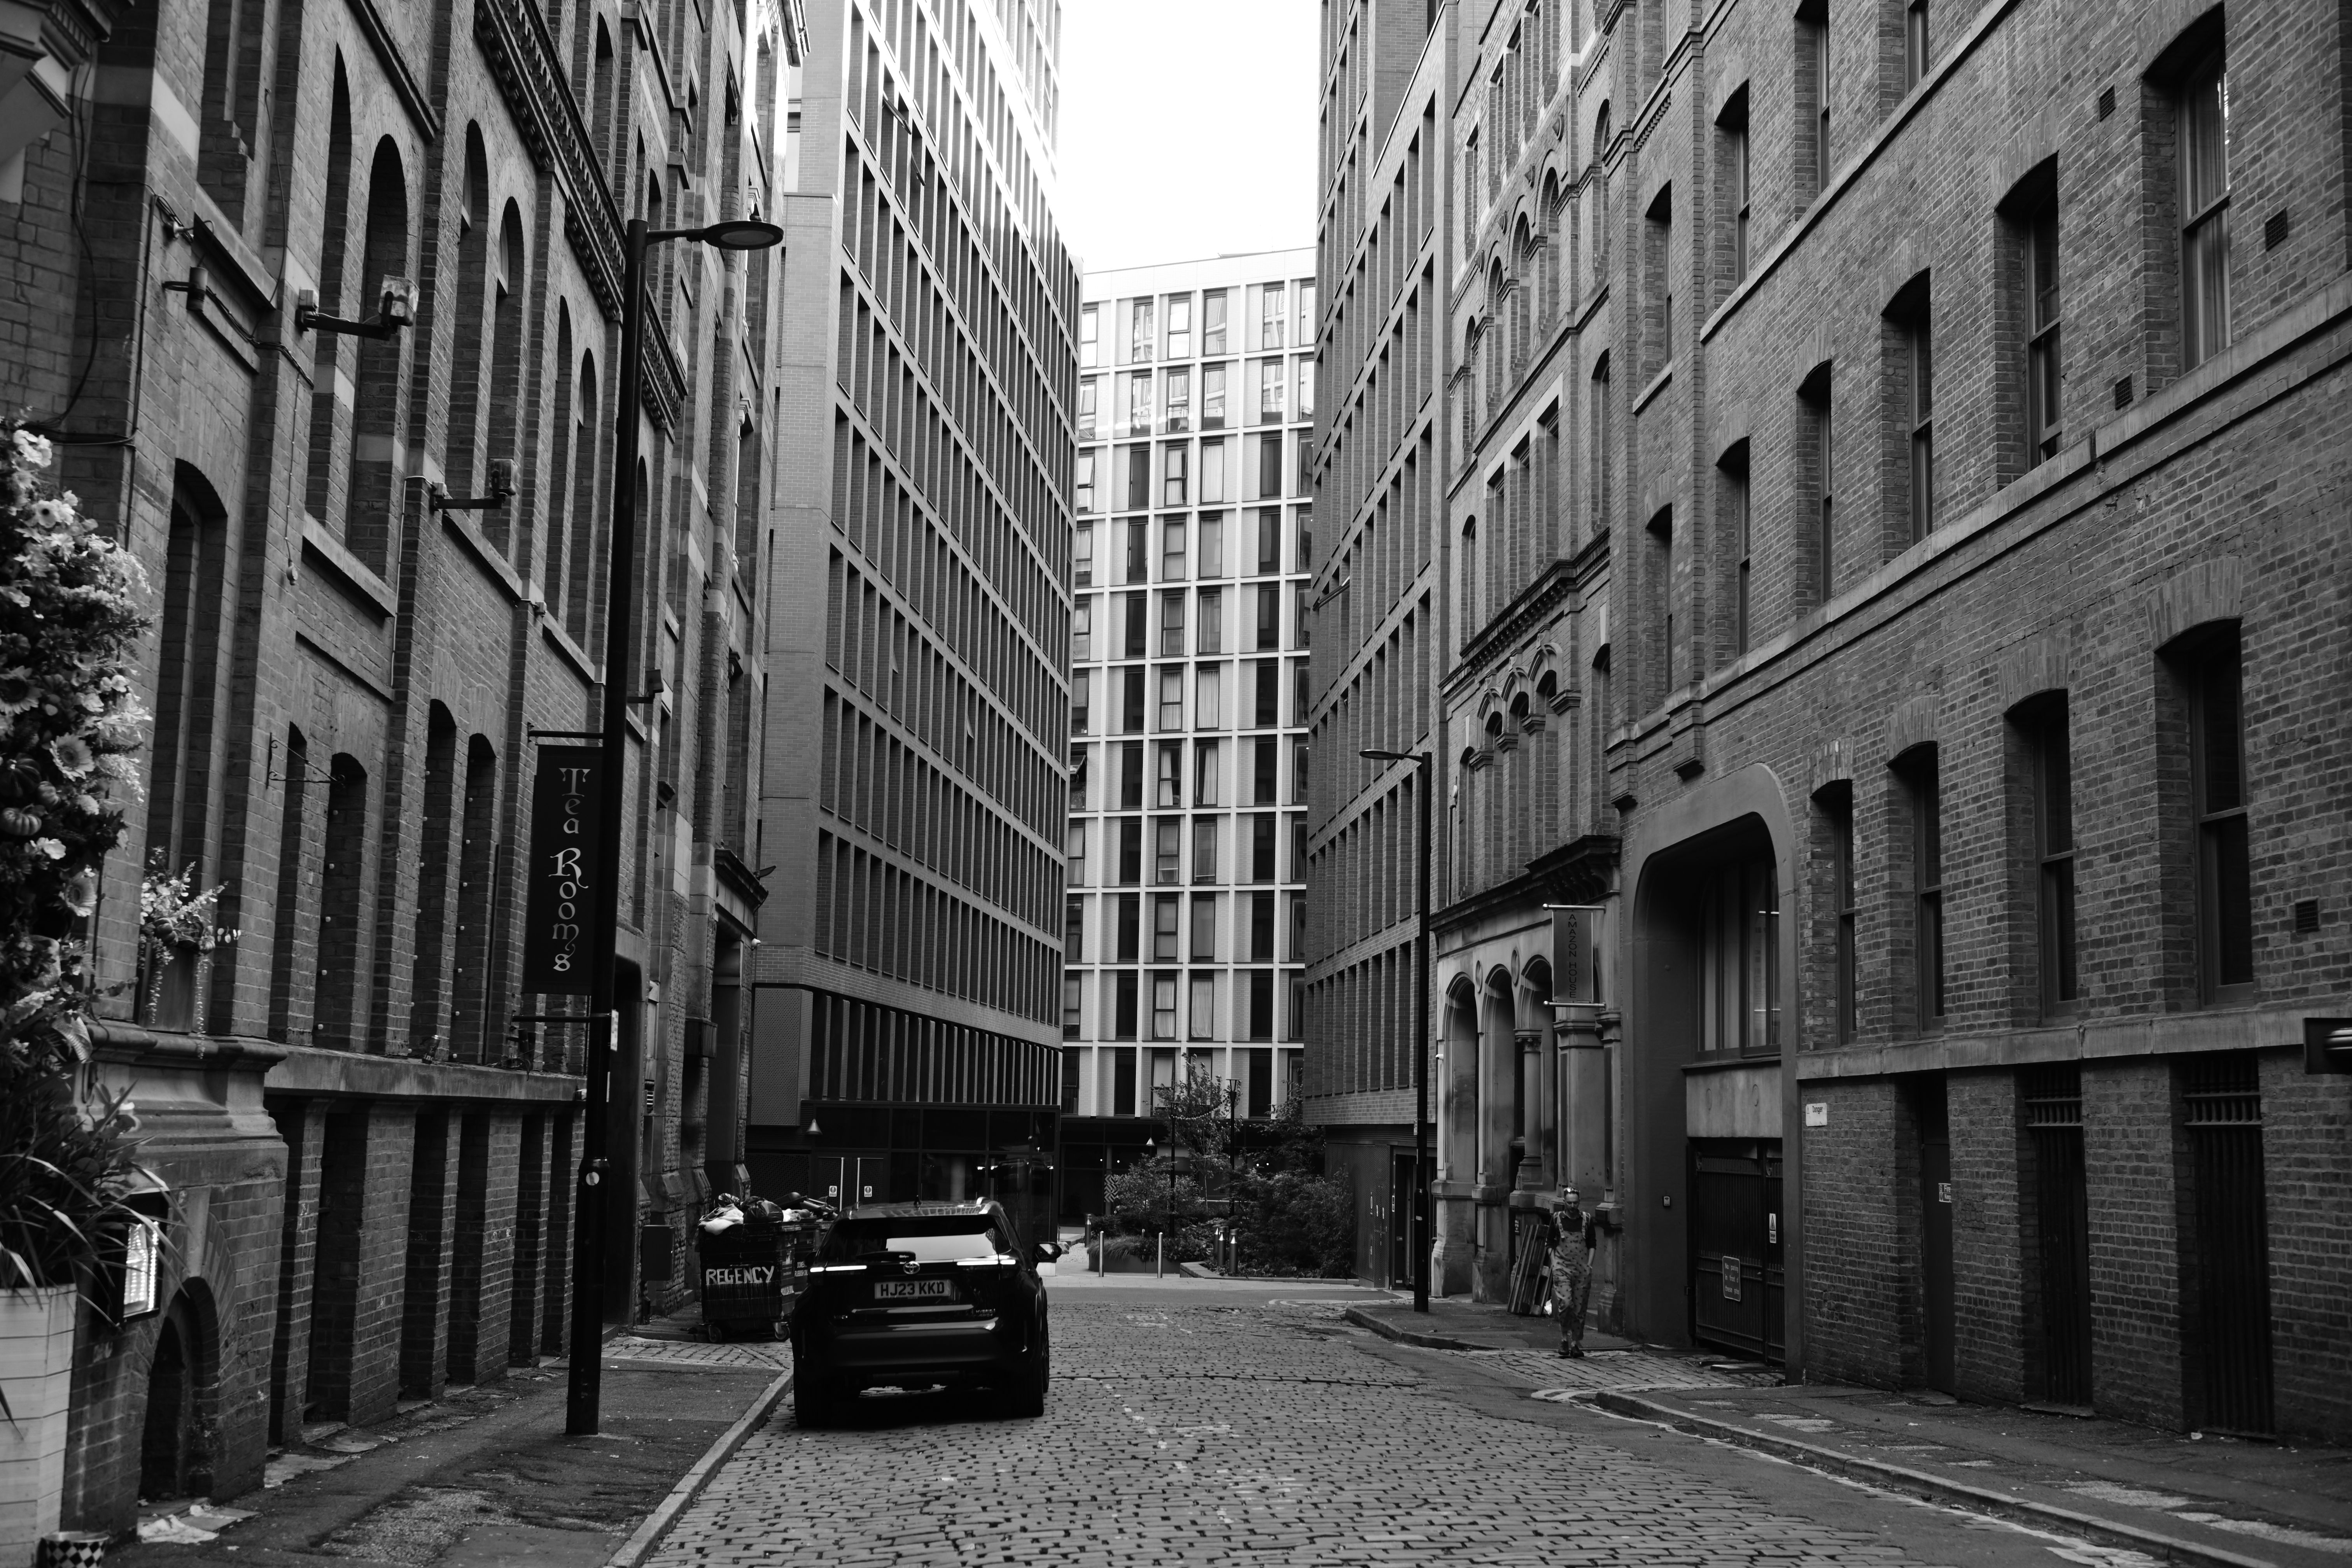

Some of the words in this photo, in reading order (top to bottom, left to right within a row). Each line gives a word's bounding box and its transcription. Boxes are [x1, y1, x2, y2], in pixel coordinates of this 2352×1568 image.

[559, 768, 591, 834] Tea
[549, 847, 589, 971] Rooms
[1568, 914, 1577, 957] AMAZON
[1569, 962, 1577, 999] HOUSE
[705, 1265, 775, 1285] REGENCY
[880, 1283, 915, 1296] HJ23
